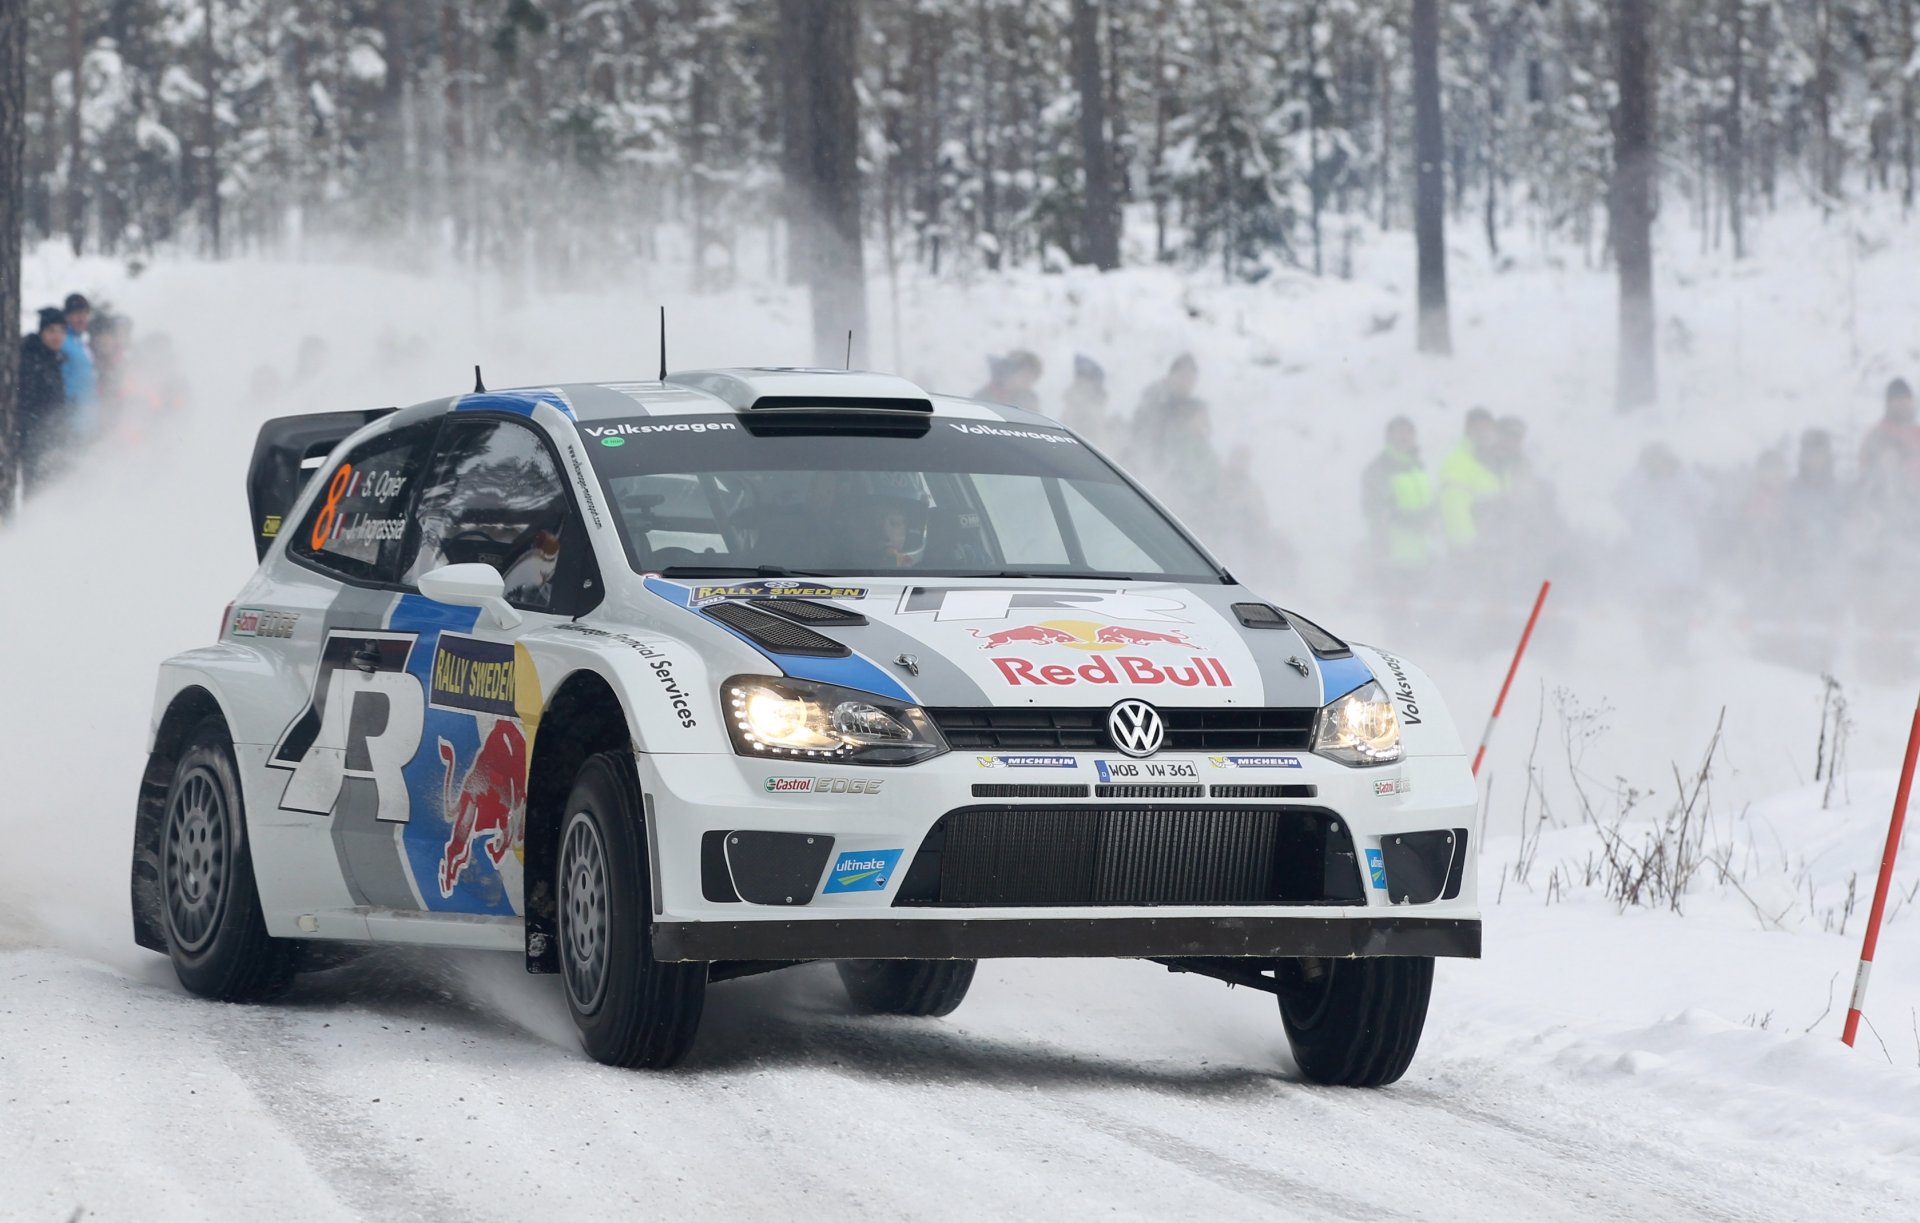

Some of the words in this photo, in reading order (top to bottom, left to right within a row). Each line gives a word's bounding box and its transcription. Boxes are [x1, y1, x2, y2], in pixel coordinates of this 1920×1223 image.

[585, 422, 736, 437] Volkswagen
[949, 423, 1078, 444] Volkswagen
[375, 470, 407, 503] Ogier
[311, 463, 352, 551] 8
[356, 512, 406, 547] Ingrassia
[699, 587, 763, 598] RALLY
[769, 588, 860, 597] SWEDEN
[435, 648, 470, 694] RALLY
[469, 660, 515, 702] SWEDEN
[991, 655, 1116, 686] Red
[1116, 656, 1232, 687] Bull
[650, 660, 697, 729] Services
[1007, 757, 1075, 765] MICHELIN
[1108, 764, 1140, 777] WOB
[1149, 764, 1166, 777] VW
[1169, 764, 1197, 777] 361
[1237, 758, 1298, 766] MICHELIN
[776, 778, 810, 791] Castrol
[815, 777, 884, 795] EDGE
[836, 858, 885, 873] ultimate
